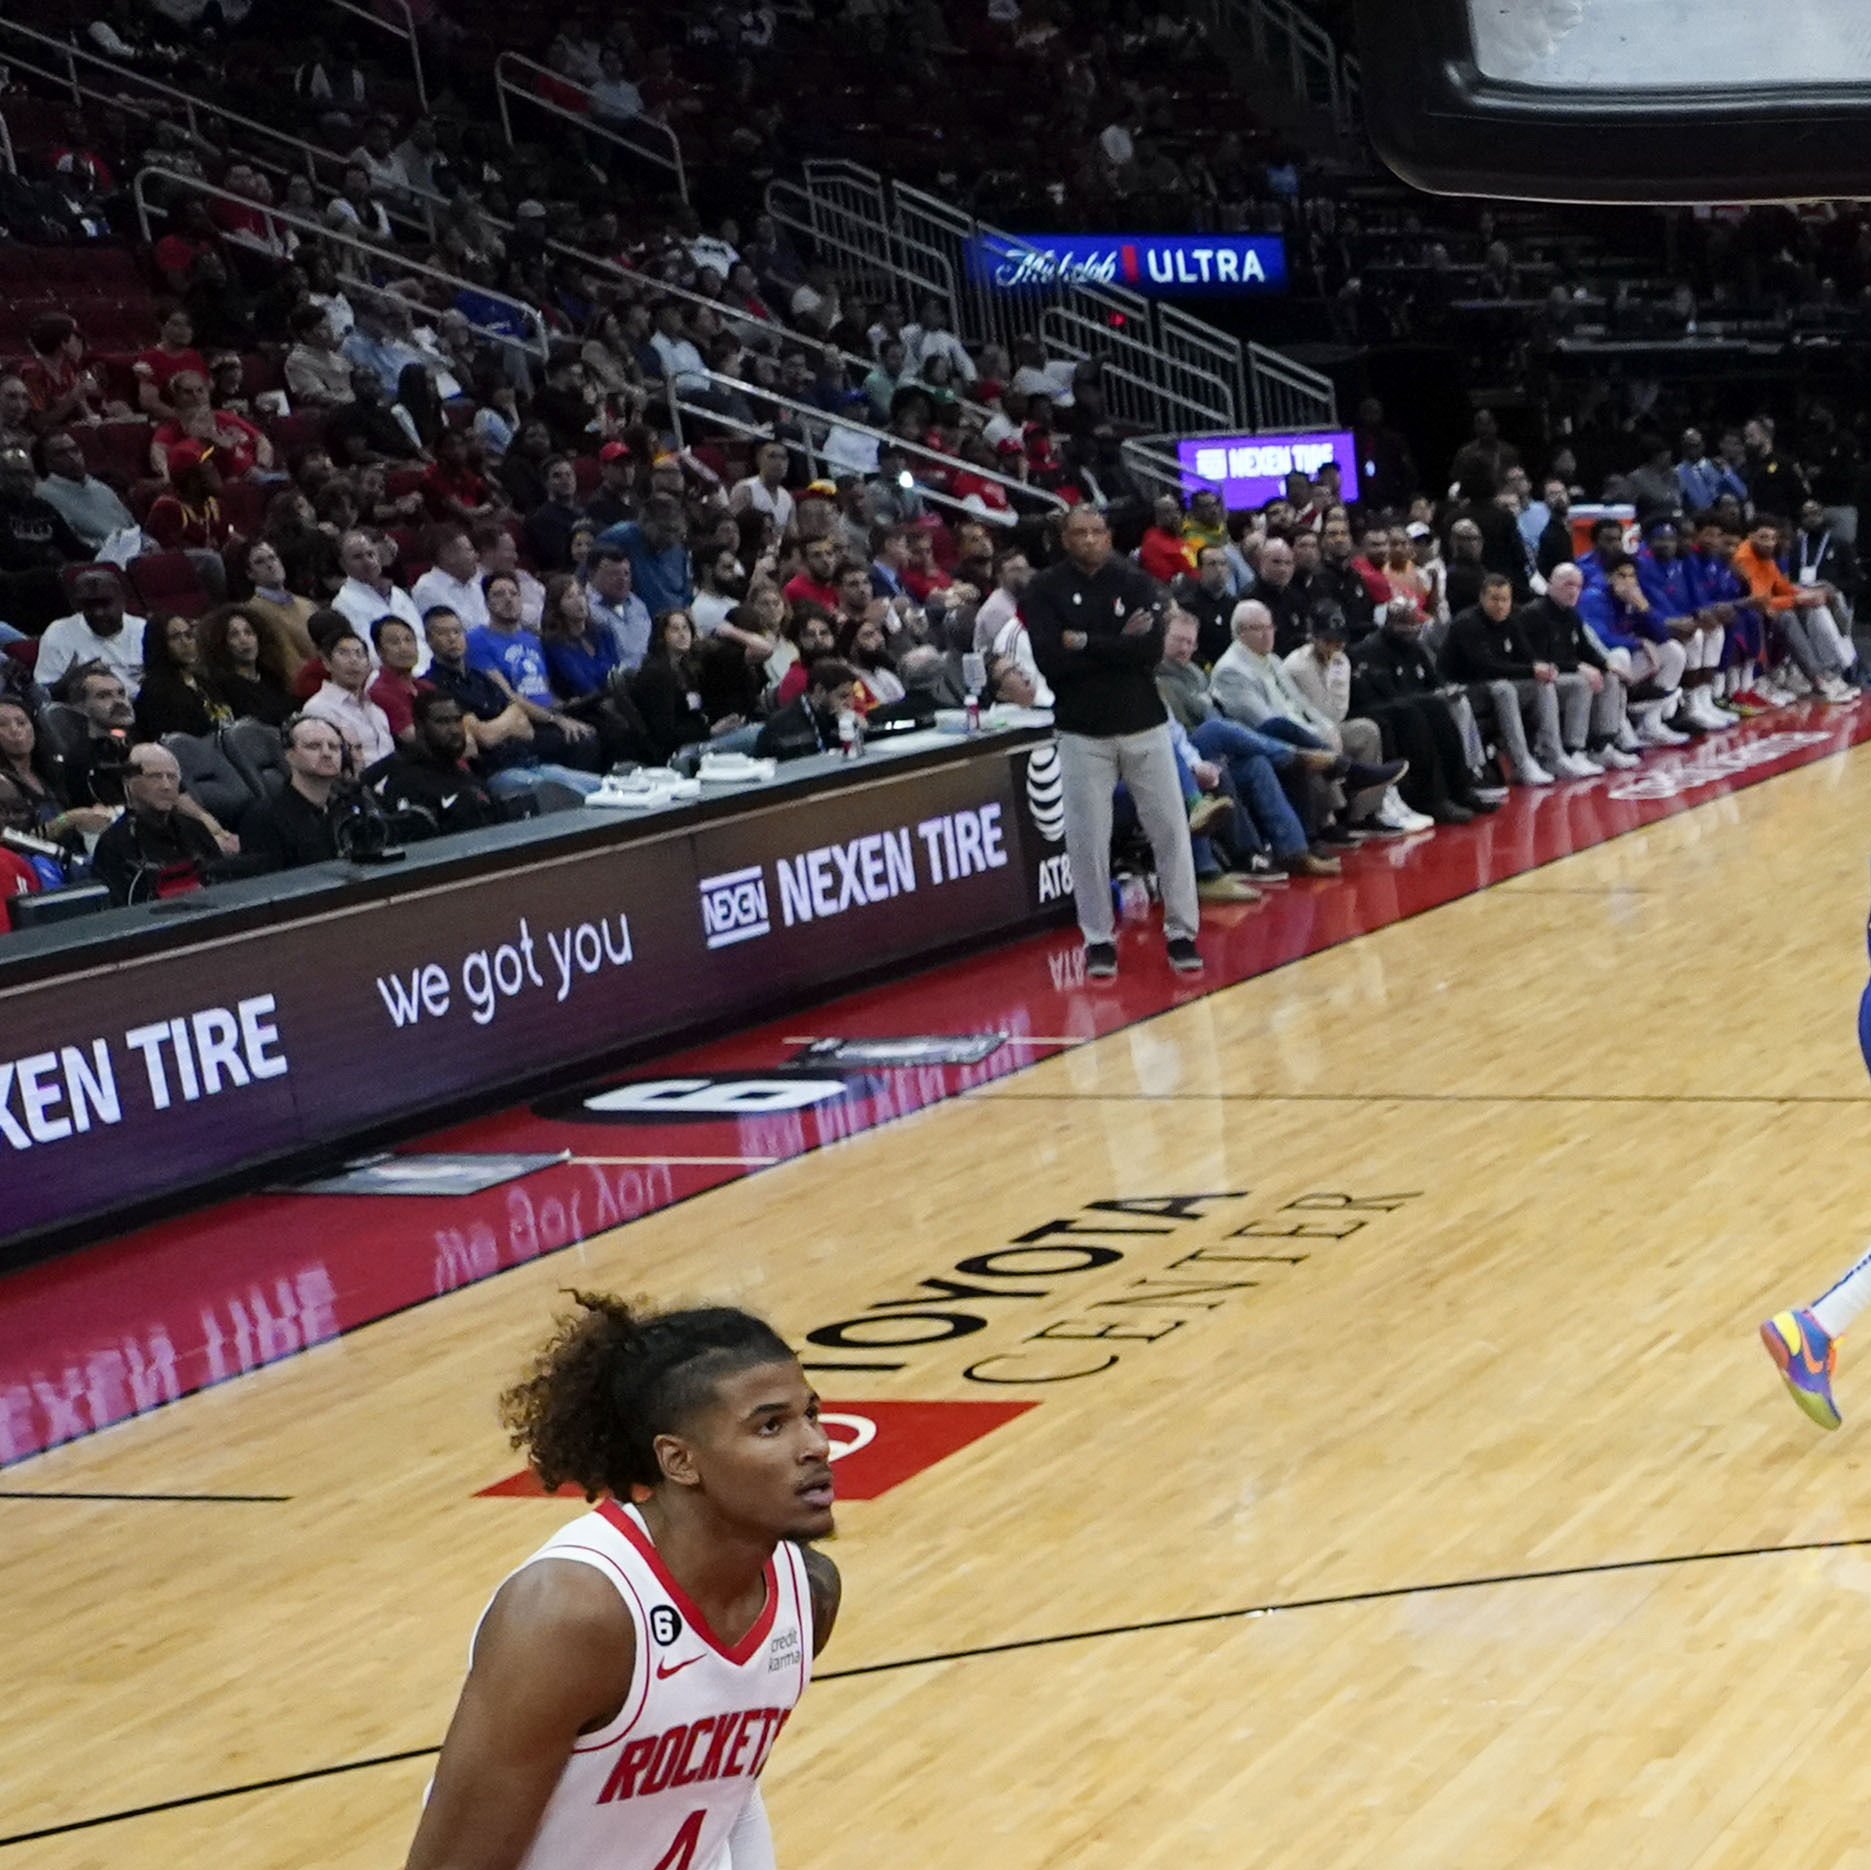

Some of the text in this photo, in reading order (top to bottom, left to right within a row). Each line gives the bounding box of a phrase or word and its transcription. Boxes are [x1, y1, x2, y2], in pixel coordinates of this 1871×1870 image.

[1147, 248, 1266, 284] ULTRA
[776, 801, 1008, 928] NEXEN TIRE
[376, 912, 634, 1027] we got you
[125, 992, 289, 1110] TIRE
[961, 1190, 1425, 1384] CENTER
[653, 1609, 674, 1643] 6
